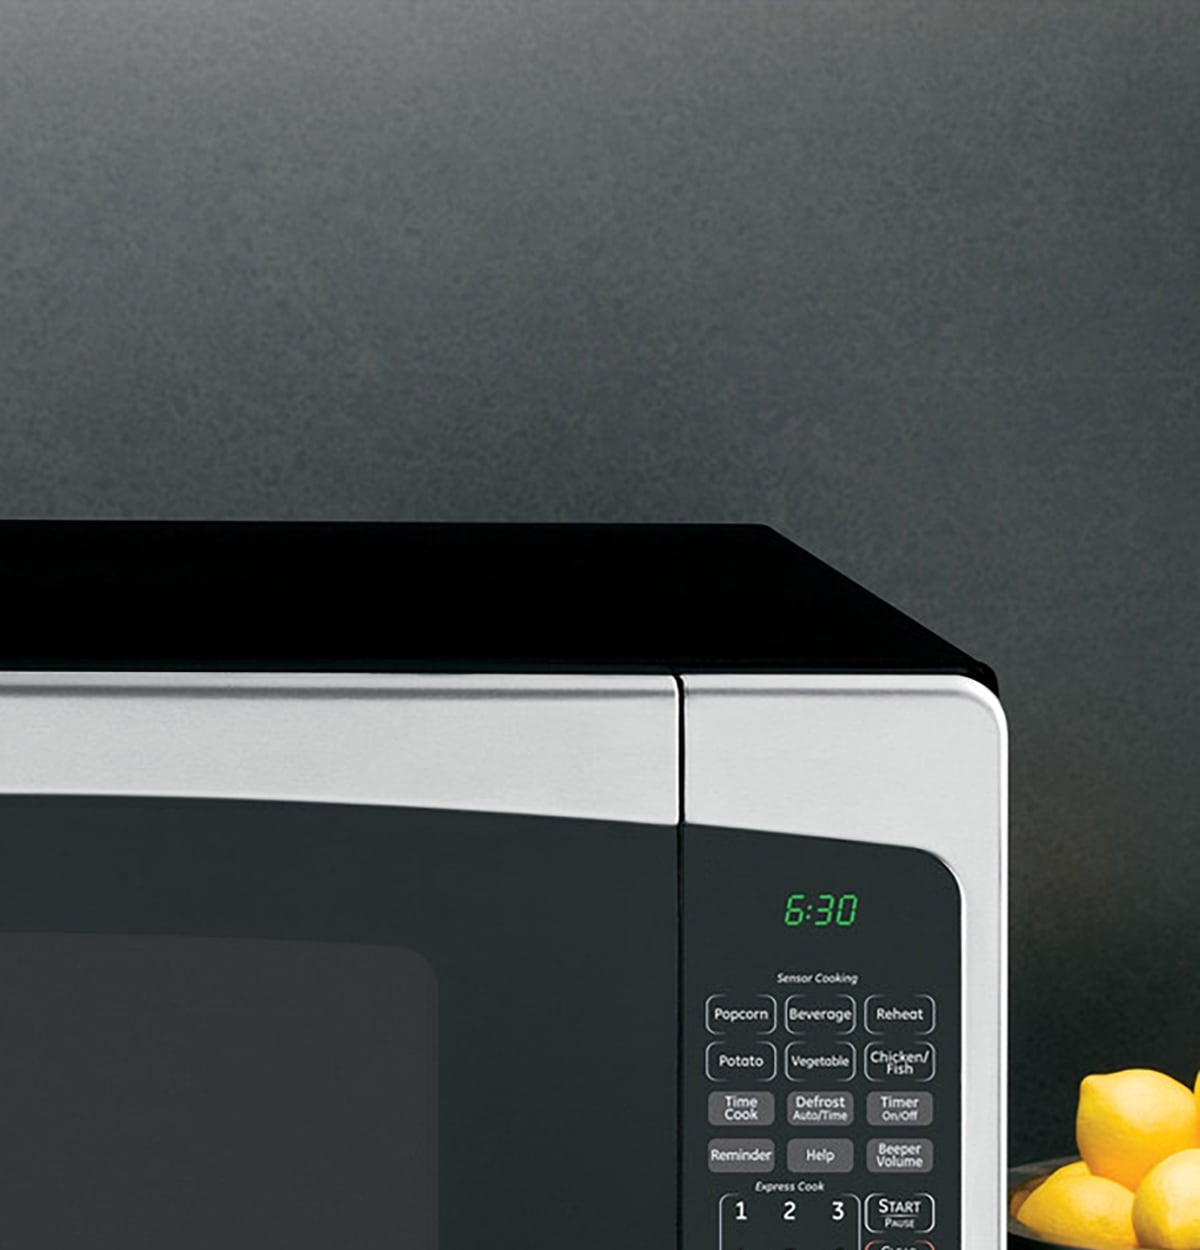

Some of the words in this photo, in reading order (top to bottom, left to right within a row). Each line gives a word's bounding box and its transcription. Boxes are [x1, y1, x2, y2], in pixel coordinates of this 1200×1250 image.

[784, 894, 858, 926] 6:30
[776, 972, 813, 984] Sensor
[814, 972, 859, 986] Cooking
[714, 1007, 769, 1023] Popcorn
[789, 1007, 853, 1024] Beverage
[876, 1007, 924, 1021] Reheat
[719, 1054, 765, 1068] Potato
[790, 1055, 850, 1070] Vegetable
[869, 1050, 930, 1065] Chicken/
[886, 1062, 914, 1075] Fish
[724, 1095, 758, 1109] Time
[795, 1094, 846, 1109] Defrost
[880, 1095, 920, 1109] Timer
[724, 1106, 759, 1121] Cook
[792, 1109, 848, 1121] Auto/Time
[881, 1110, 919, 1122] On/Off
[710, 1148, 773, 1162] Reminder
[806, 1148, 836, 1164] Help
[876, 1142, 922, 1158] Beeper
[876, 1155, 924, 1168] Volume
[754, 1180, 796, 1193] Express
[797, 1180, 825, 1192] Cook
[735, 1201, 748, 1220] 1
[783, 1200, 796, 1221] 2
[832, 1201, 845, 1221] 3
